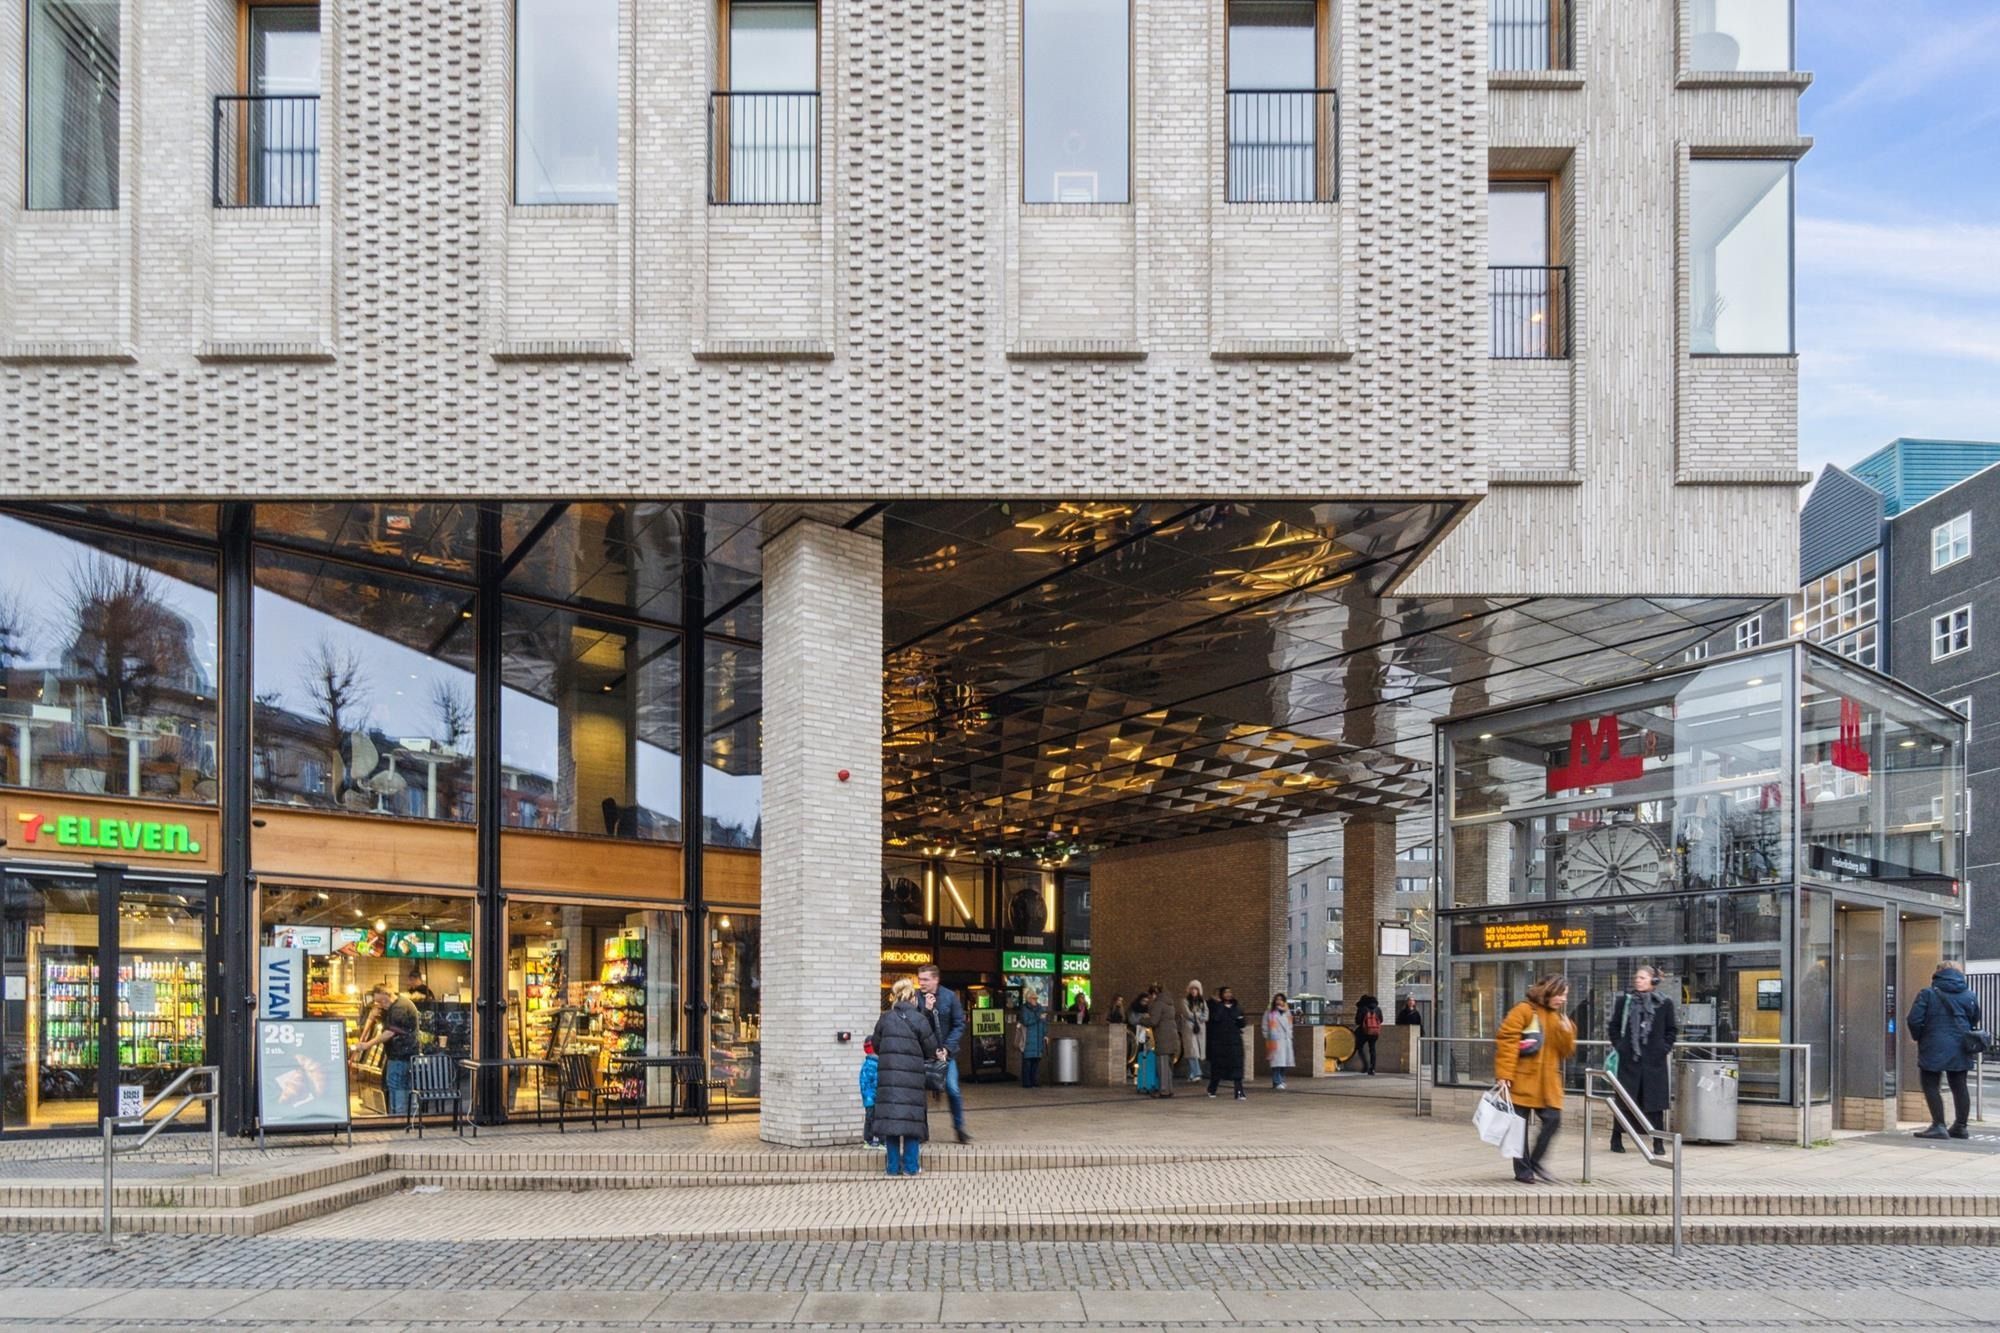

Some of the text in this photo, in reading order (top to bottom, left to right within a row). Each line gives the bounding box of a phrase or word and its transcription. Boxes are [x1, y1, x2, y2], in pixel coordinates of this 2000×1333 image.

[1557, 937, 1569, 945] out
[1571, 936, 1580, 944] of
[1011, 954, 1048, 969] DÖNER
[1063, 958, 1090, 971] SCHÖ
